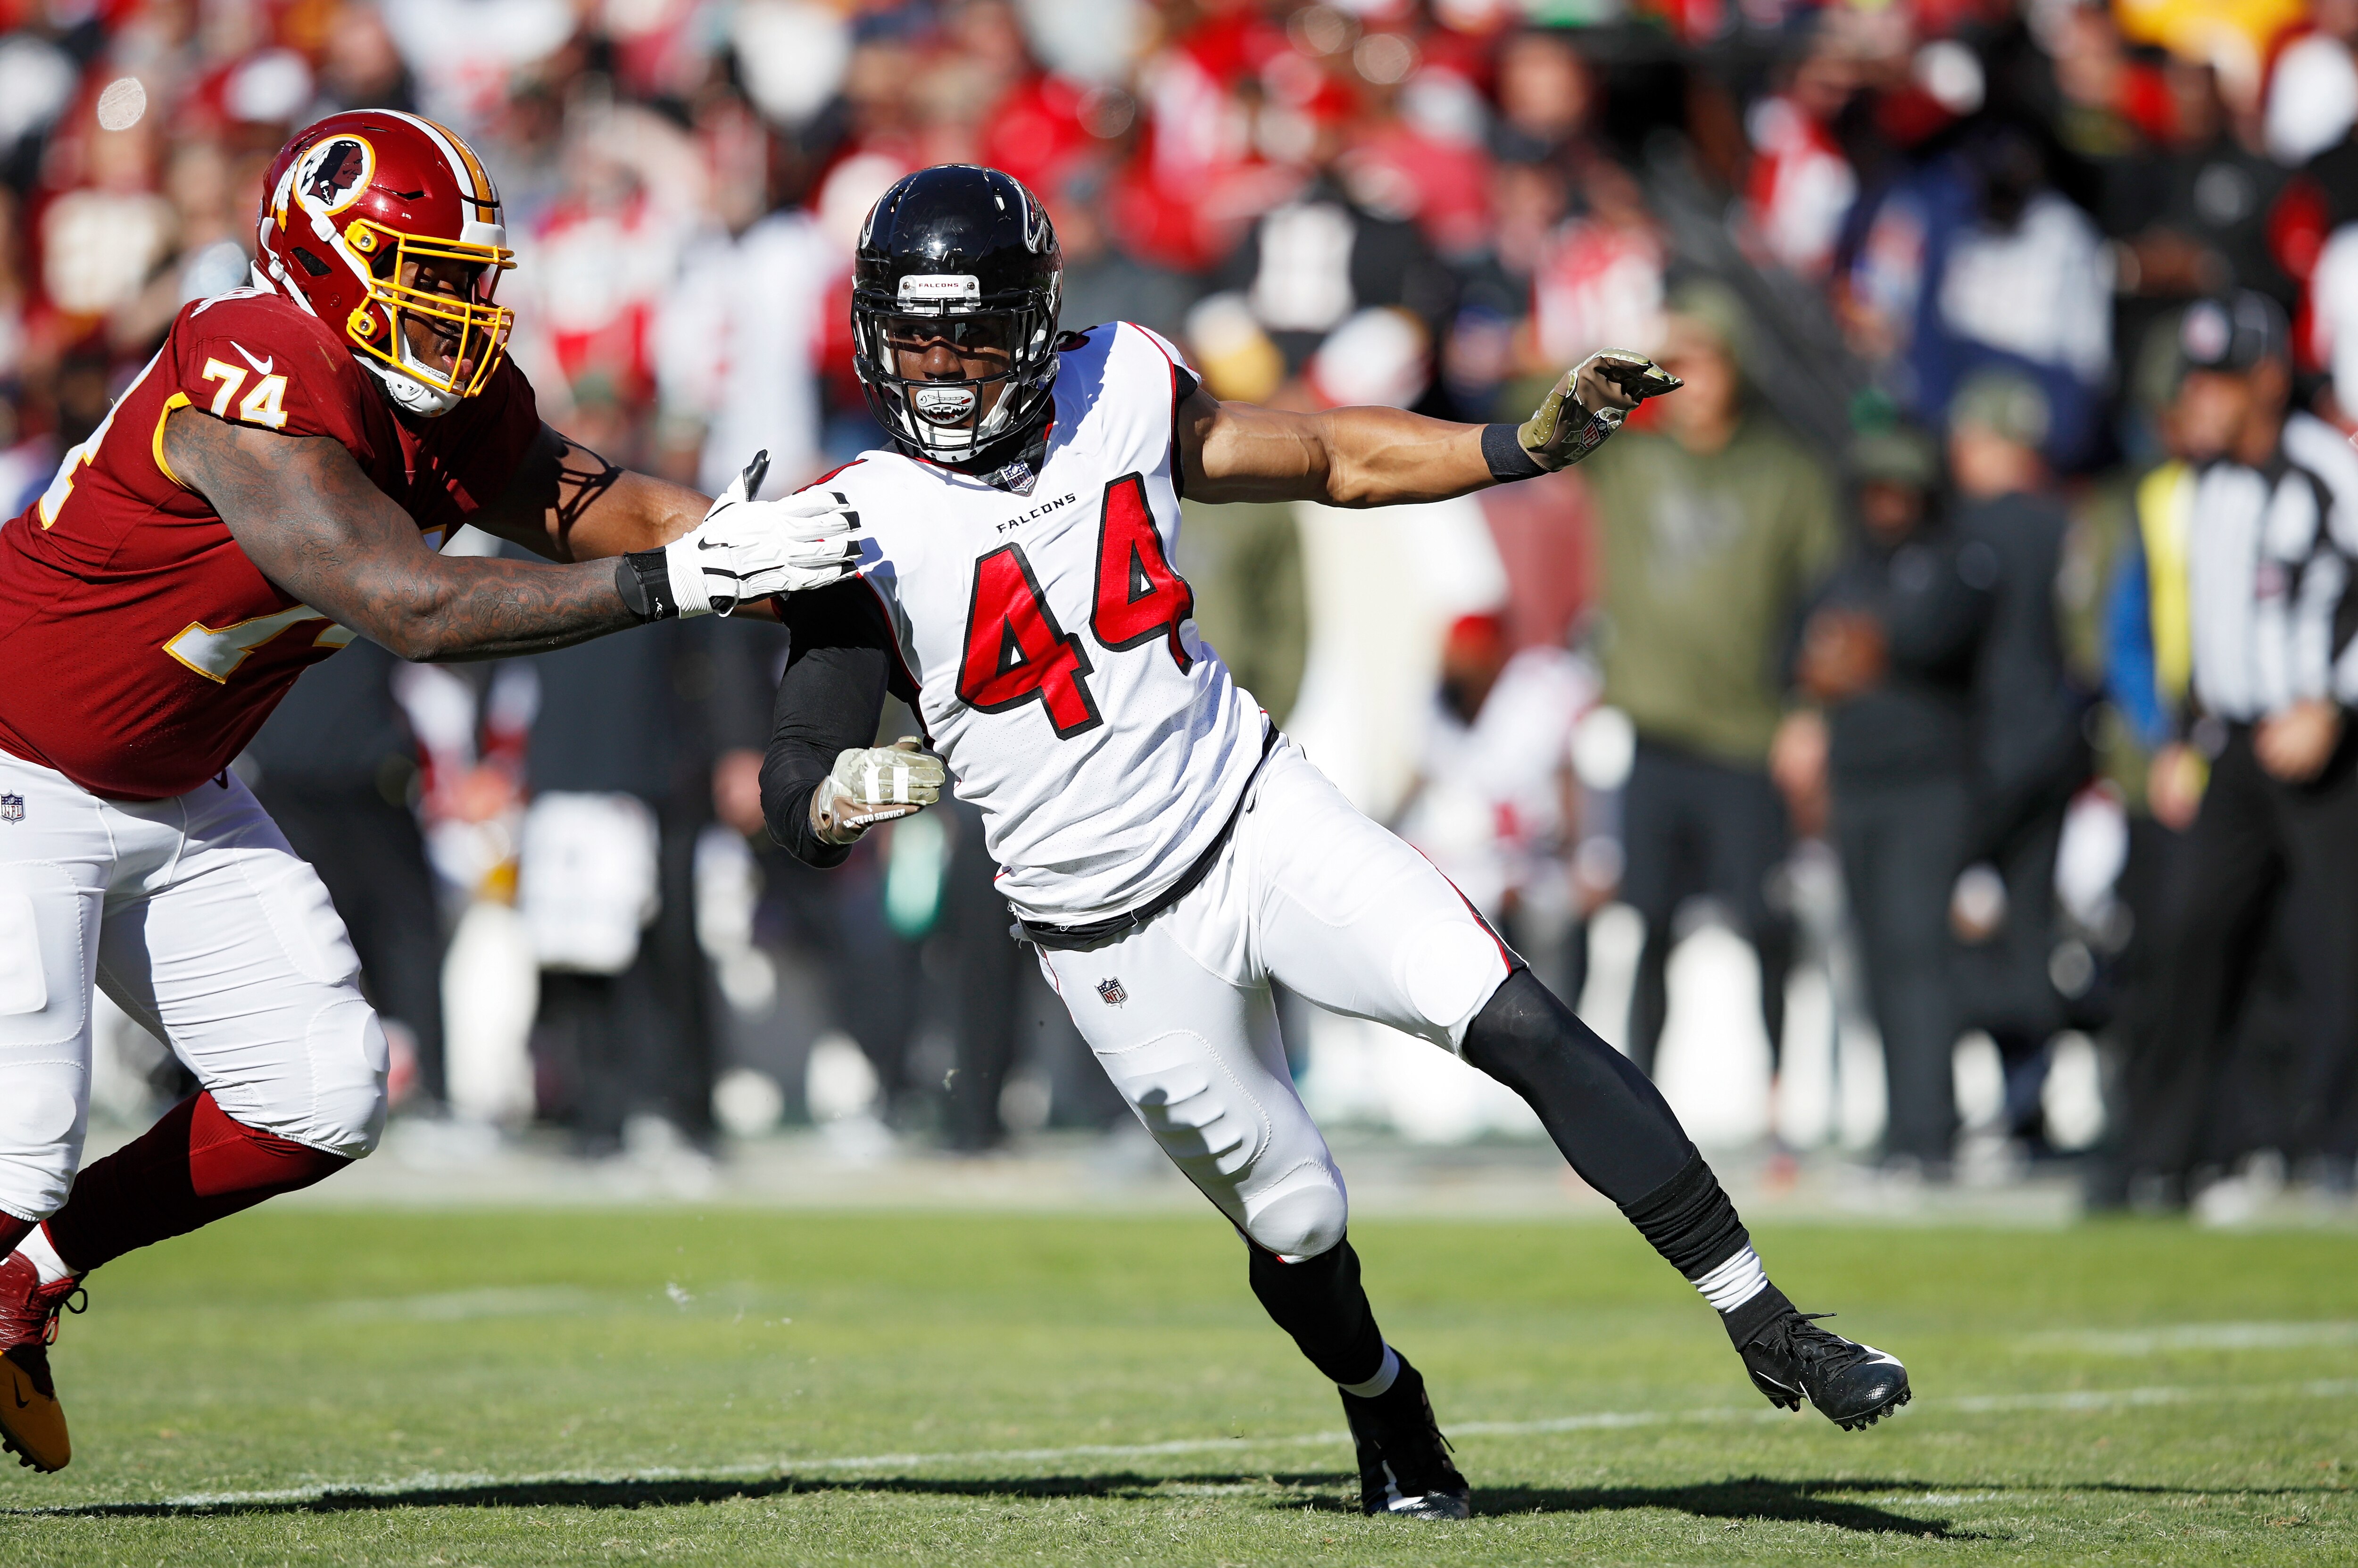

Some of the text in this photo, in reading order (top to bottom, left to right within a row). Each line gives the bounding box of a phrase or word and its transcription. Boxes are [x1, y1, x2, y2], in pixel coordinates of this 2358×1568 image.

[202, 357, 288, 430] 74
[1583, 423, 1600, 448] NFL
[1011, 473, 1031, 488] NFL
[996, 493, 1076, 534] FALCONS
[955, 471, 1194, 741] 44
[4, 805, 22, 818] NFL
[863, 813, 874, 822] TO
[874, 808, 905, 821] SERVICE
[1104, 988, 1124, 1002] NFL
